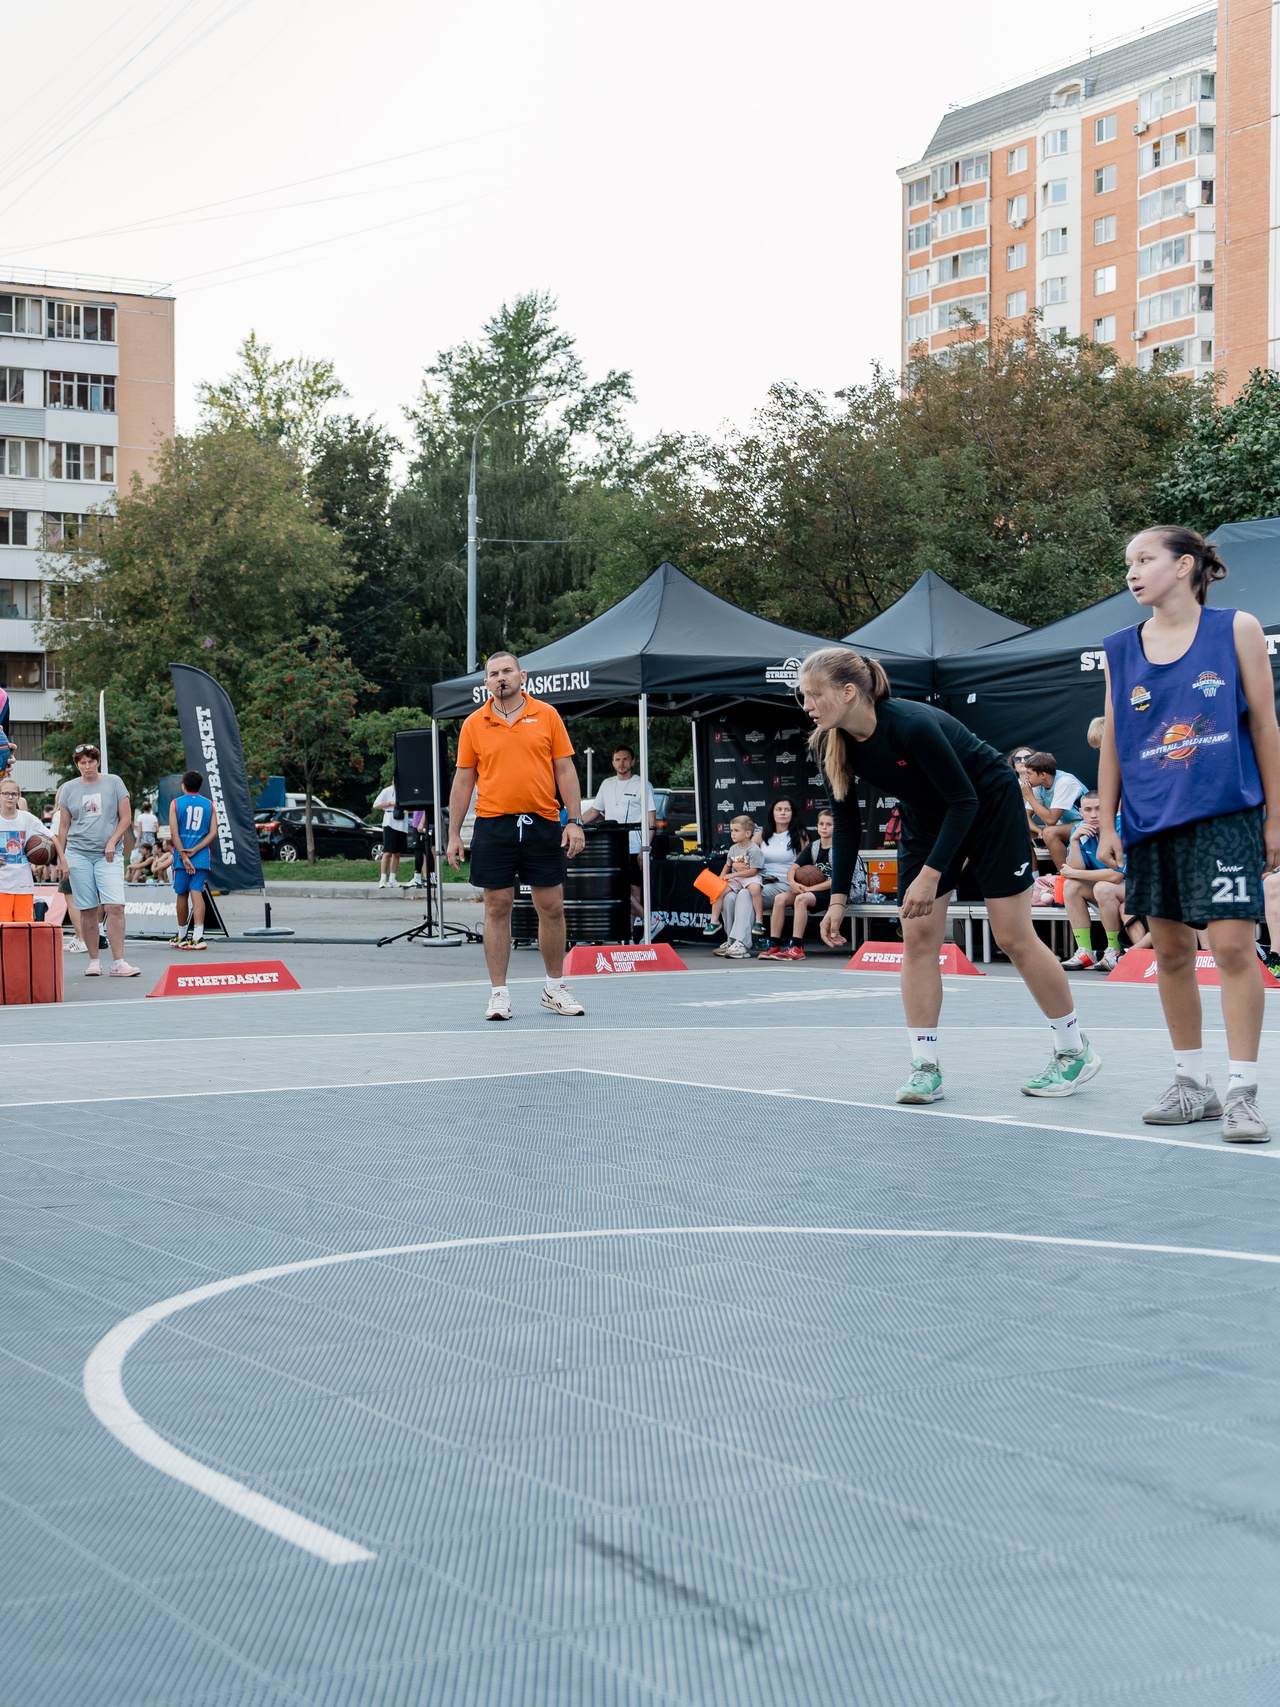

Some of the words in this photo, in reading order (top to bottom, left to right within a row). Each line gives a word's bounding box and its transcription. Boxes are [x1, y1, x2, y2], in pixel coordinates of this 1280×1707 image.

[765, 671, 798, 679] STREETB
[472, 670, 590, 704] STASKET.RU
[195, 706, 237, 865] STREETBASKET
[185, 805, 204, 831] 19
[1211, 875, 1251, 903] 21
[610, 949, 658, 962] МОСКОВСКИЙ
[861, 952, 948, 965] STREETT
[613, 961, 637, 972] СПОРТ
[177, 972, 279, 988] STREETBASKET
